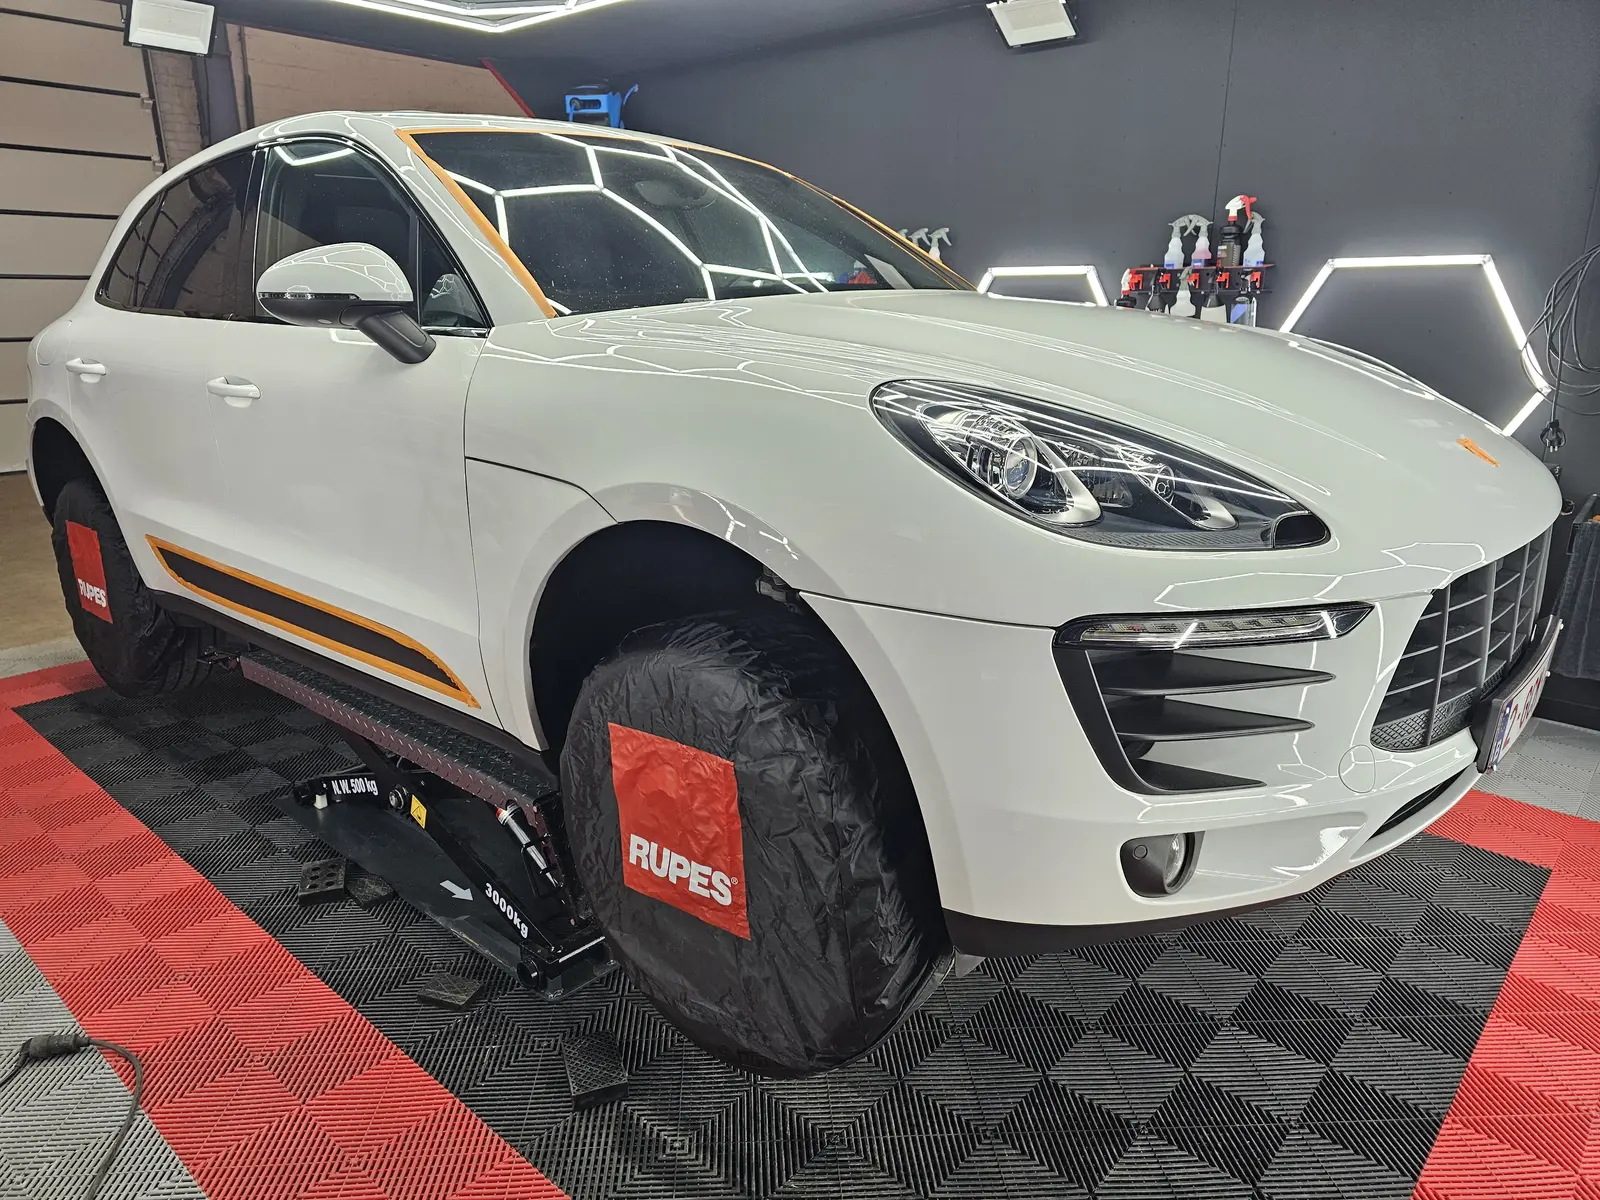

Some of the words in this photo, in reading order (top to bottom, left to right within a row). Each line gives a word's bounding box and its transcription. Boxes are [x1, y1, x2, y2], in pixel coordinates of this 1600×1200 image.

[77, 578, 107, 608] RUPES
[350, 778, 366, 793] 500
[364, 777, 378, 796] kg
[485, 882, 529, 938] 3000kg
